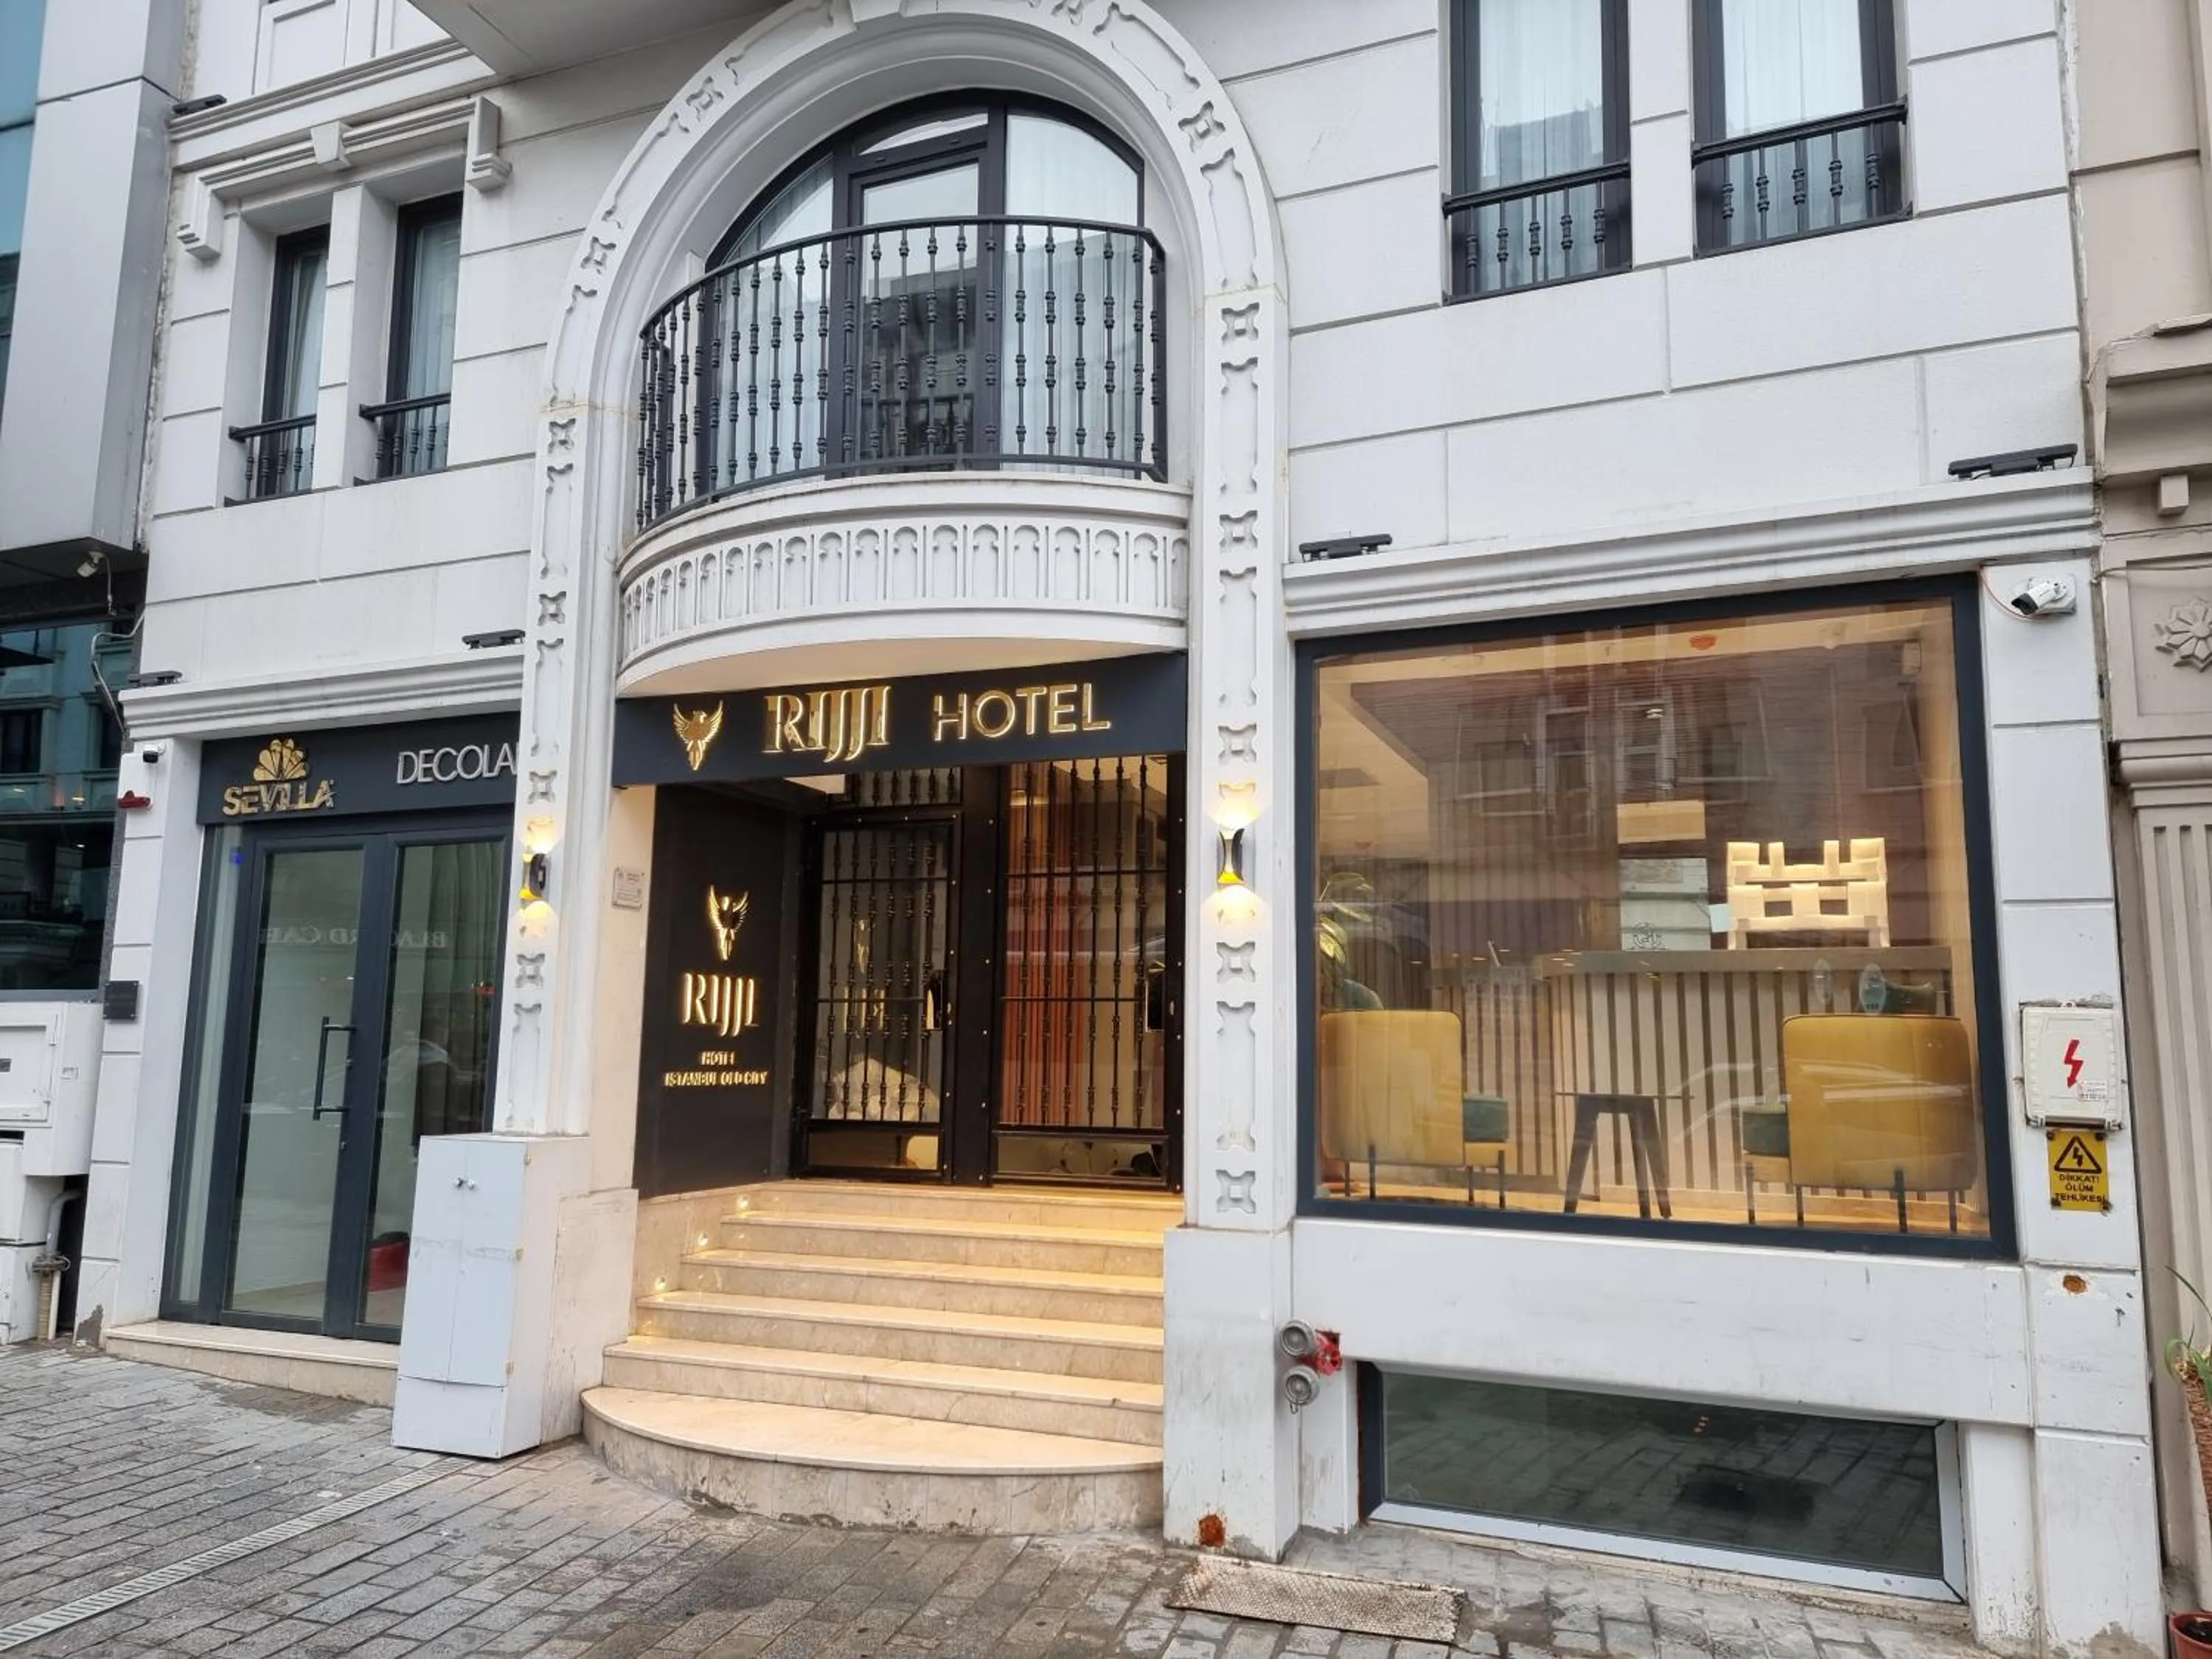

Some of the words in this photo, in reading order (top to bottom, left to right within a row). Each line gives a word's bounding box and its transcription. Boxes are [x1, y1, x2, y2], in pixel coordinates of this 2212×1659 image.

[933, 683, 1111, 741] HOTEL
[396, 742, 519, 784] DECOLA
[222, 779, 336, 815] SEVILLA
[700, 1050, 737, 1065] HOTEL
